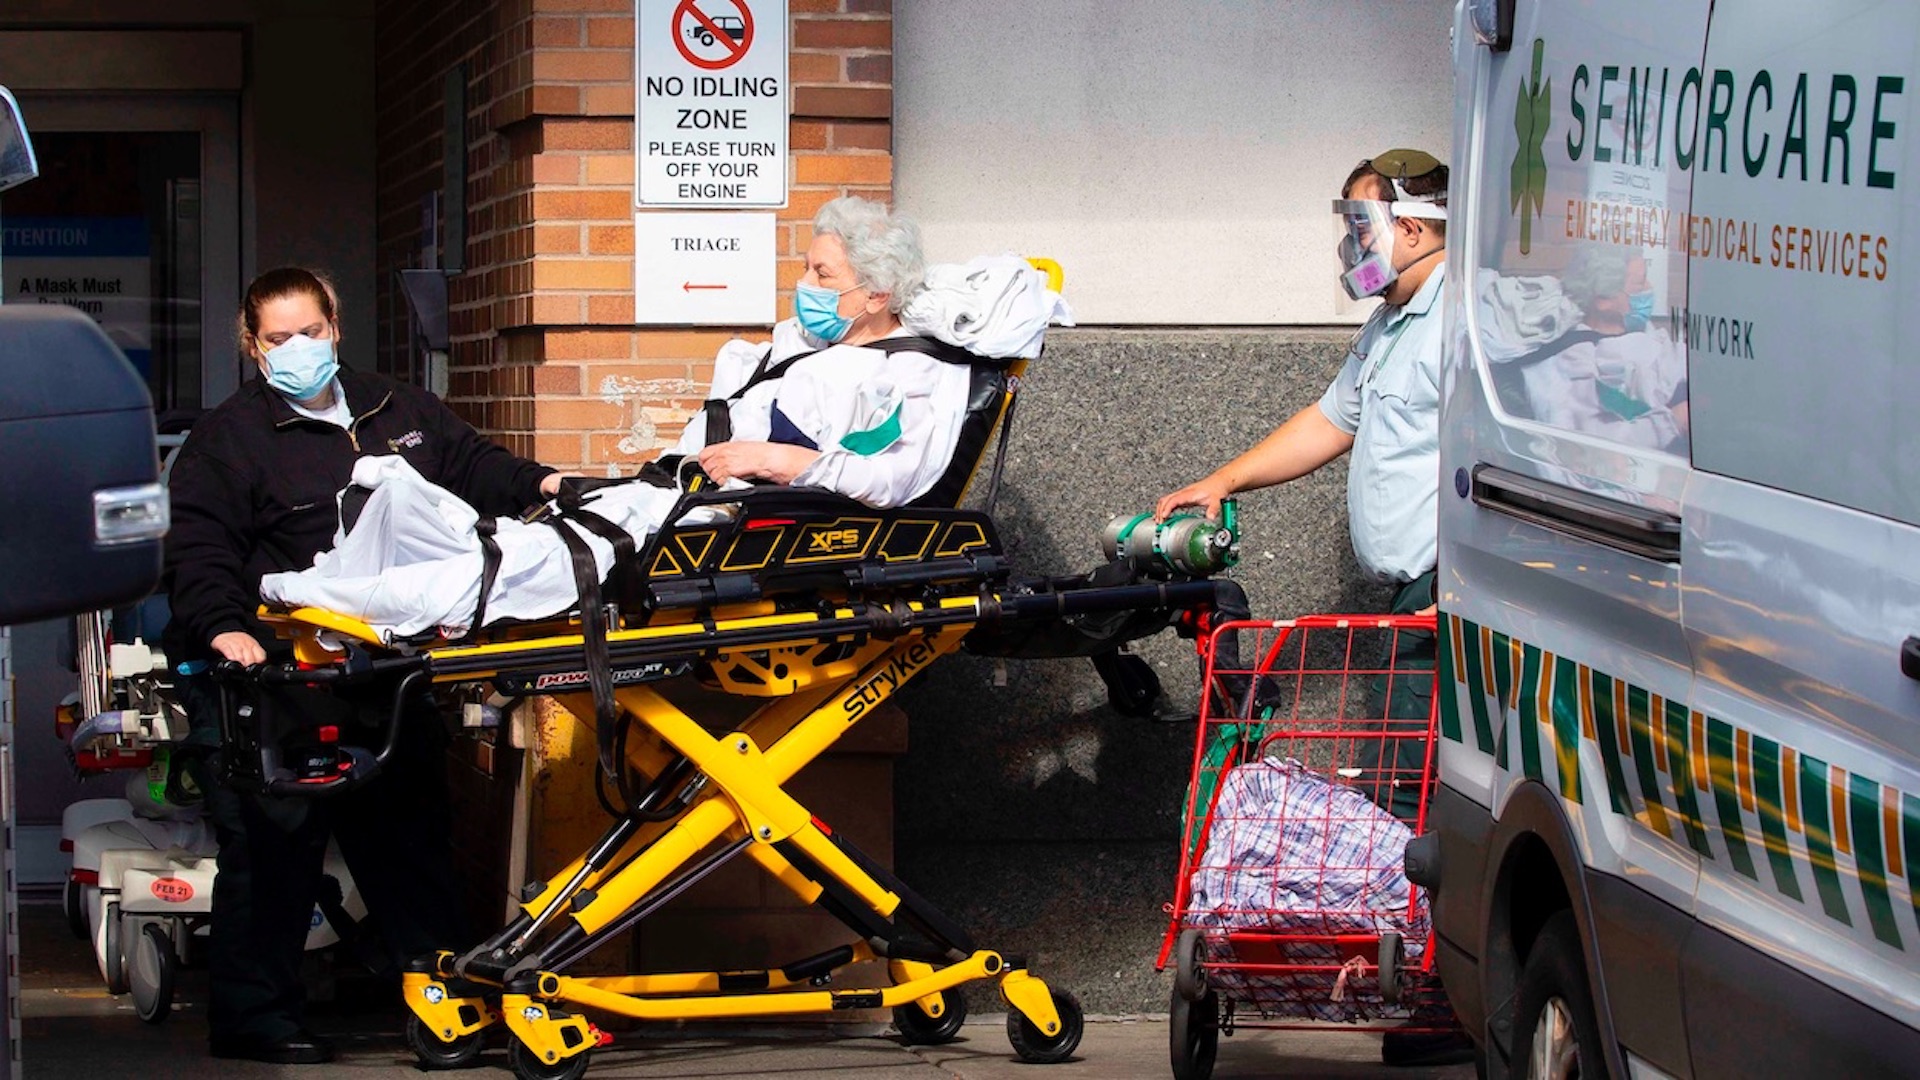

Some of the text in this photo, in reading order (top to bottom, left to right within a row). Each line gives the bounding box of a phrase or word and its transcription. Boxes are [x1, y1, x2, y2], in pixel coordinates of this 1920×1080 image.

[647, 77, 778, 97] NO IDLING
[676, 108, 747, 130] ZONE
[1566, 64, 1904, 189] SENIORCARE
[649, 142, 775, 157] PLEASE TURN
[666, 163, 758, 177] OFF YOUR
[678, 183, 747, 199] ENGINE
[2, 228, 88, 246] TTENTION
[671, 238, 740, 251] TRIAGE
[1566, 200, 1888, 281] EMERGENCY MEDICAL SERVICES
[19, 278, 122, 294] A Mask Must
[1705, 314, 1754, 360] YORK
[810, 528, 860, 553] XPS
[843, 632, 938, 722] stryker
[156, 883, 188, 896] FEB 21
